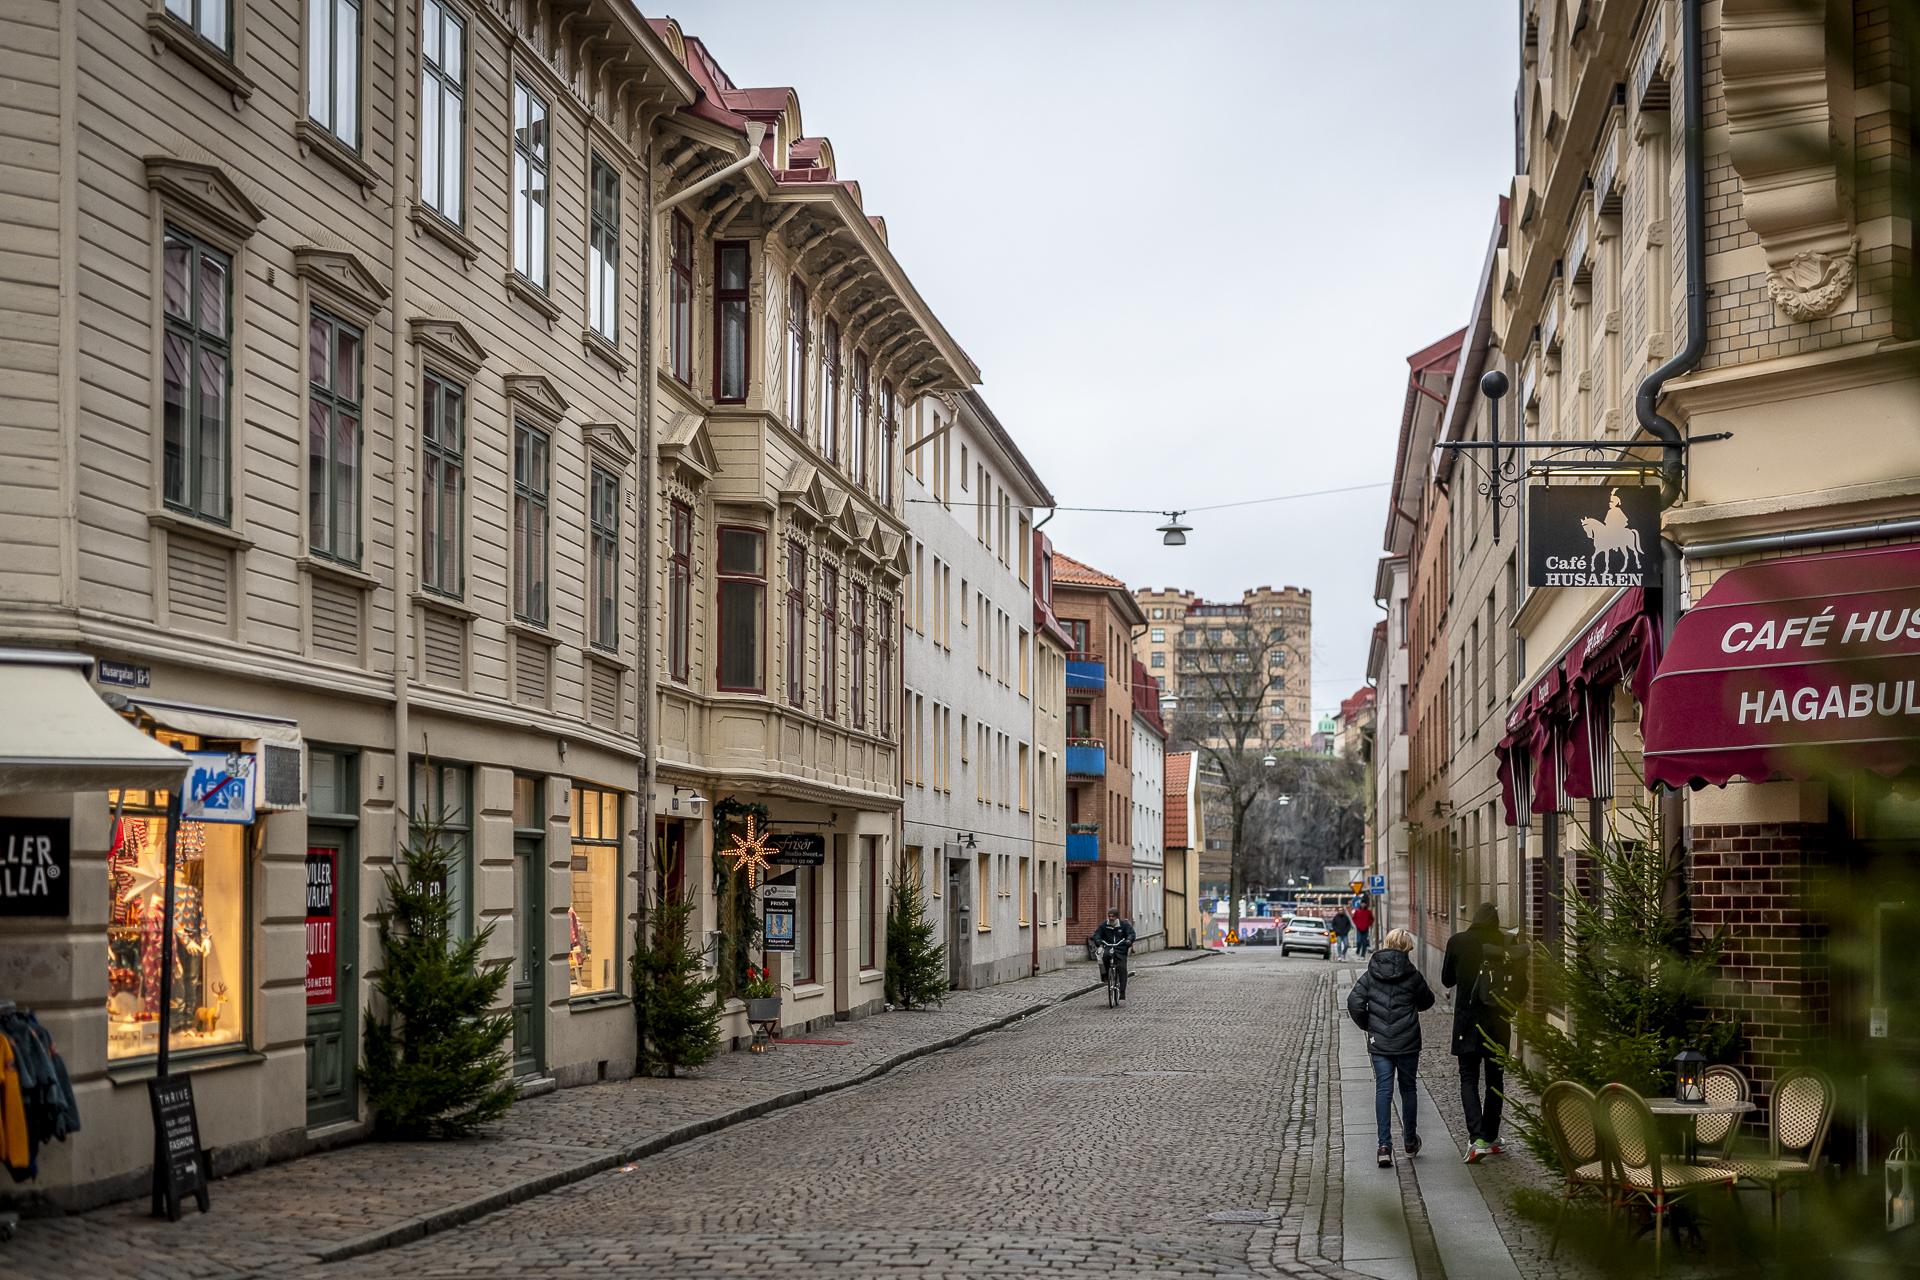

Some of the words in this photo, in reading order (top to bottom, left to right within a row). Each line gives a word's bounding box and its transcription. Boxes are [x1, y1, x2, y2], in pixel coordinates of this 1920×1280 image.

[1545, 556, 1587, 570] Café
[1545, 573, 1643, 586] HUSAREN
[1720, 606, 1834, 653] CAFÉ
[1738, 680, 1920, 724] HAGABUL
[0, 835, 53, 865] LER
[0, 866, 48, 896] LLA
[160, 1088, 189, 1105] THRIVE
[169, 1136, 194, 1151] FASHION
